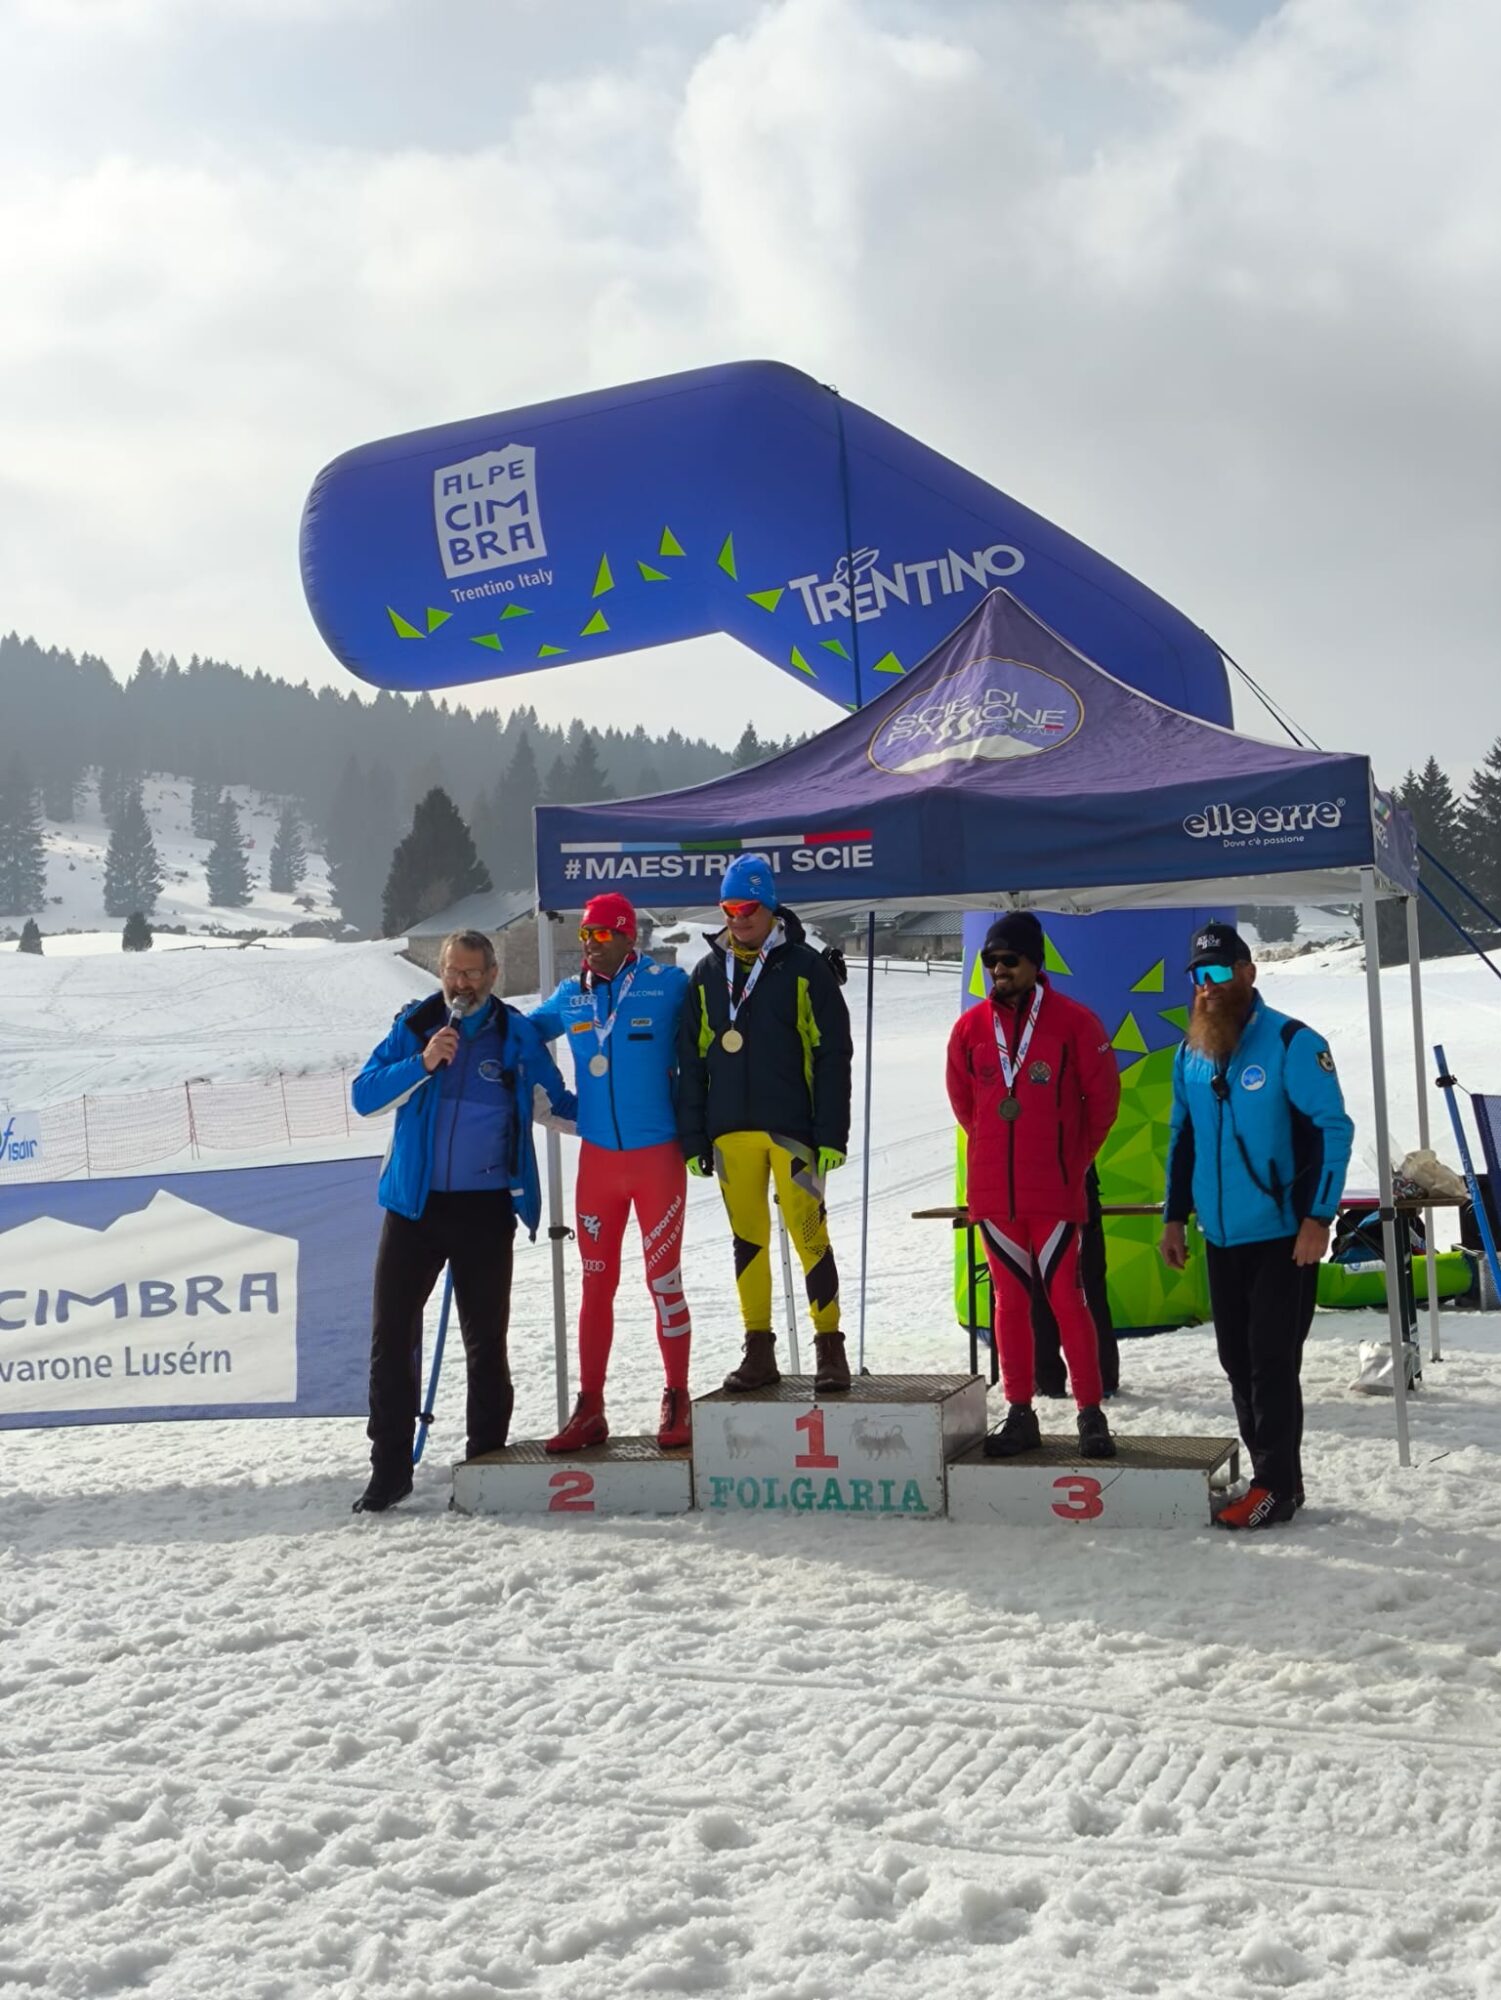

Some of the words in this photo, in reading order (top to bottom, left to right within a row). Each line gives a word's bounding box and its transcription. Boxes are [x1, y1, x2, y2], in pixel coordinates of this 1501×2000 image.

[443, 459, 526, 496] ALPE
[445, 490, 529, 531] CIM
[448, 522, 535, 566] BRA
[451, 580, 515, 603] Trentino
[518, 568, 553, 588] Italy
[788, 545, 1026, 625] TRENTINO
[887, 705, 1066, 747] PASSIONE
[893, 694, 971, 731] SCIE
[984, 688, 1018, 706] DI
[1183, 801, 1342, 838] elleerre
[792, 845, 873, 872] SCIE
[1223, 839, 1246, 848] Dove
[1264, 835, 1305, 846] passione
[624, 990, 664, 998] ALCONERI
[650, 1195, 682, 1240] sportful
[0, 1272, 279, 1330] CIMBRA
[0, 1354, 113, 1382] varone
[124, 1342, 232, 1377] Lusérn
[795, 1409, 839, 1468] 1
[548, 1471, 595, 1512] 2
[709, 1476, 929, 1513] FOLGARIA
[1051, 1475, 1104, 1520] 3
